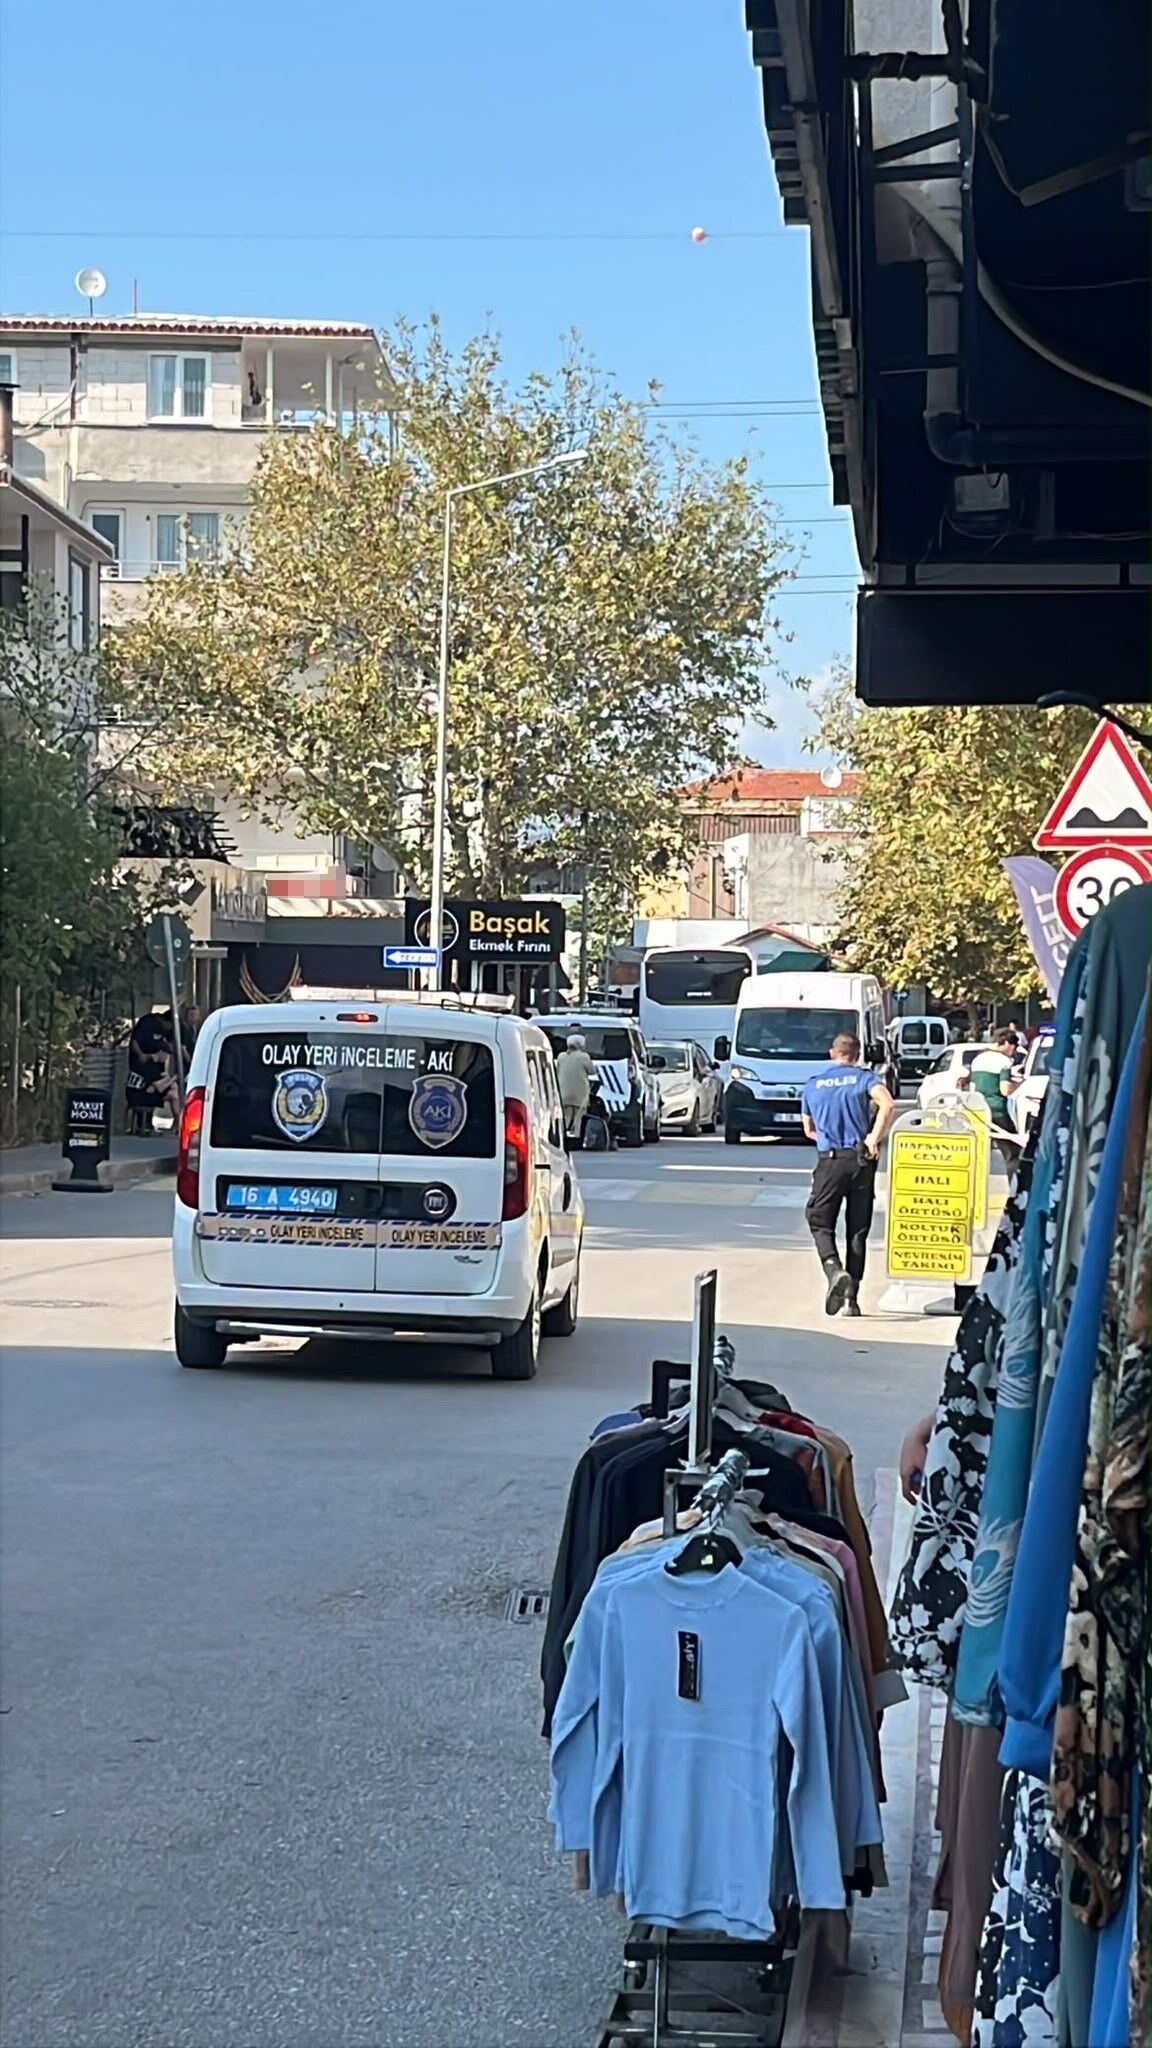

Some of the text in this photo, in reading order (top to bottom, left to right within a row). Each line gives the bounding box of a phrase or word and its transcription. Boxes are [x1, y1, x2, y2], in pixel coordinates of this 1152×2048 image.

[469, 910, 550, 939] Başak
[469, 939, 550, 953] Ekmek Fırını
[262, 1043, 301, 1065] OLAY
[71, 1110, 104, 1120] HOME
[915, 1175, 950, 1185] HALI
[241, 1187, 333, 1206] 16 A 4940
[913, 1197, 949, 1206] HALI
[270, 1224, 294, 1238] OLAY
[900, 1223, 960, 1233] KOLTUK
[391, 1229, 416, 1242] OLAY
